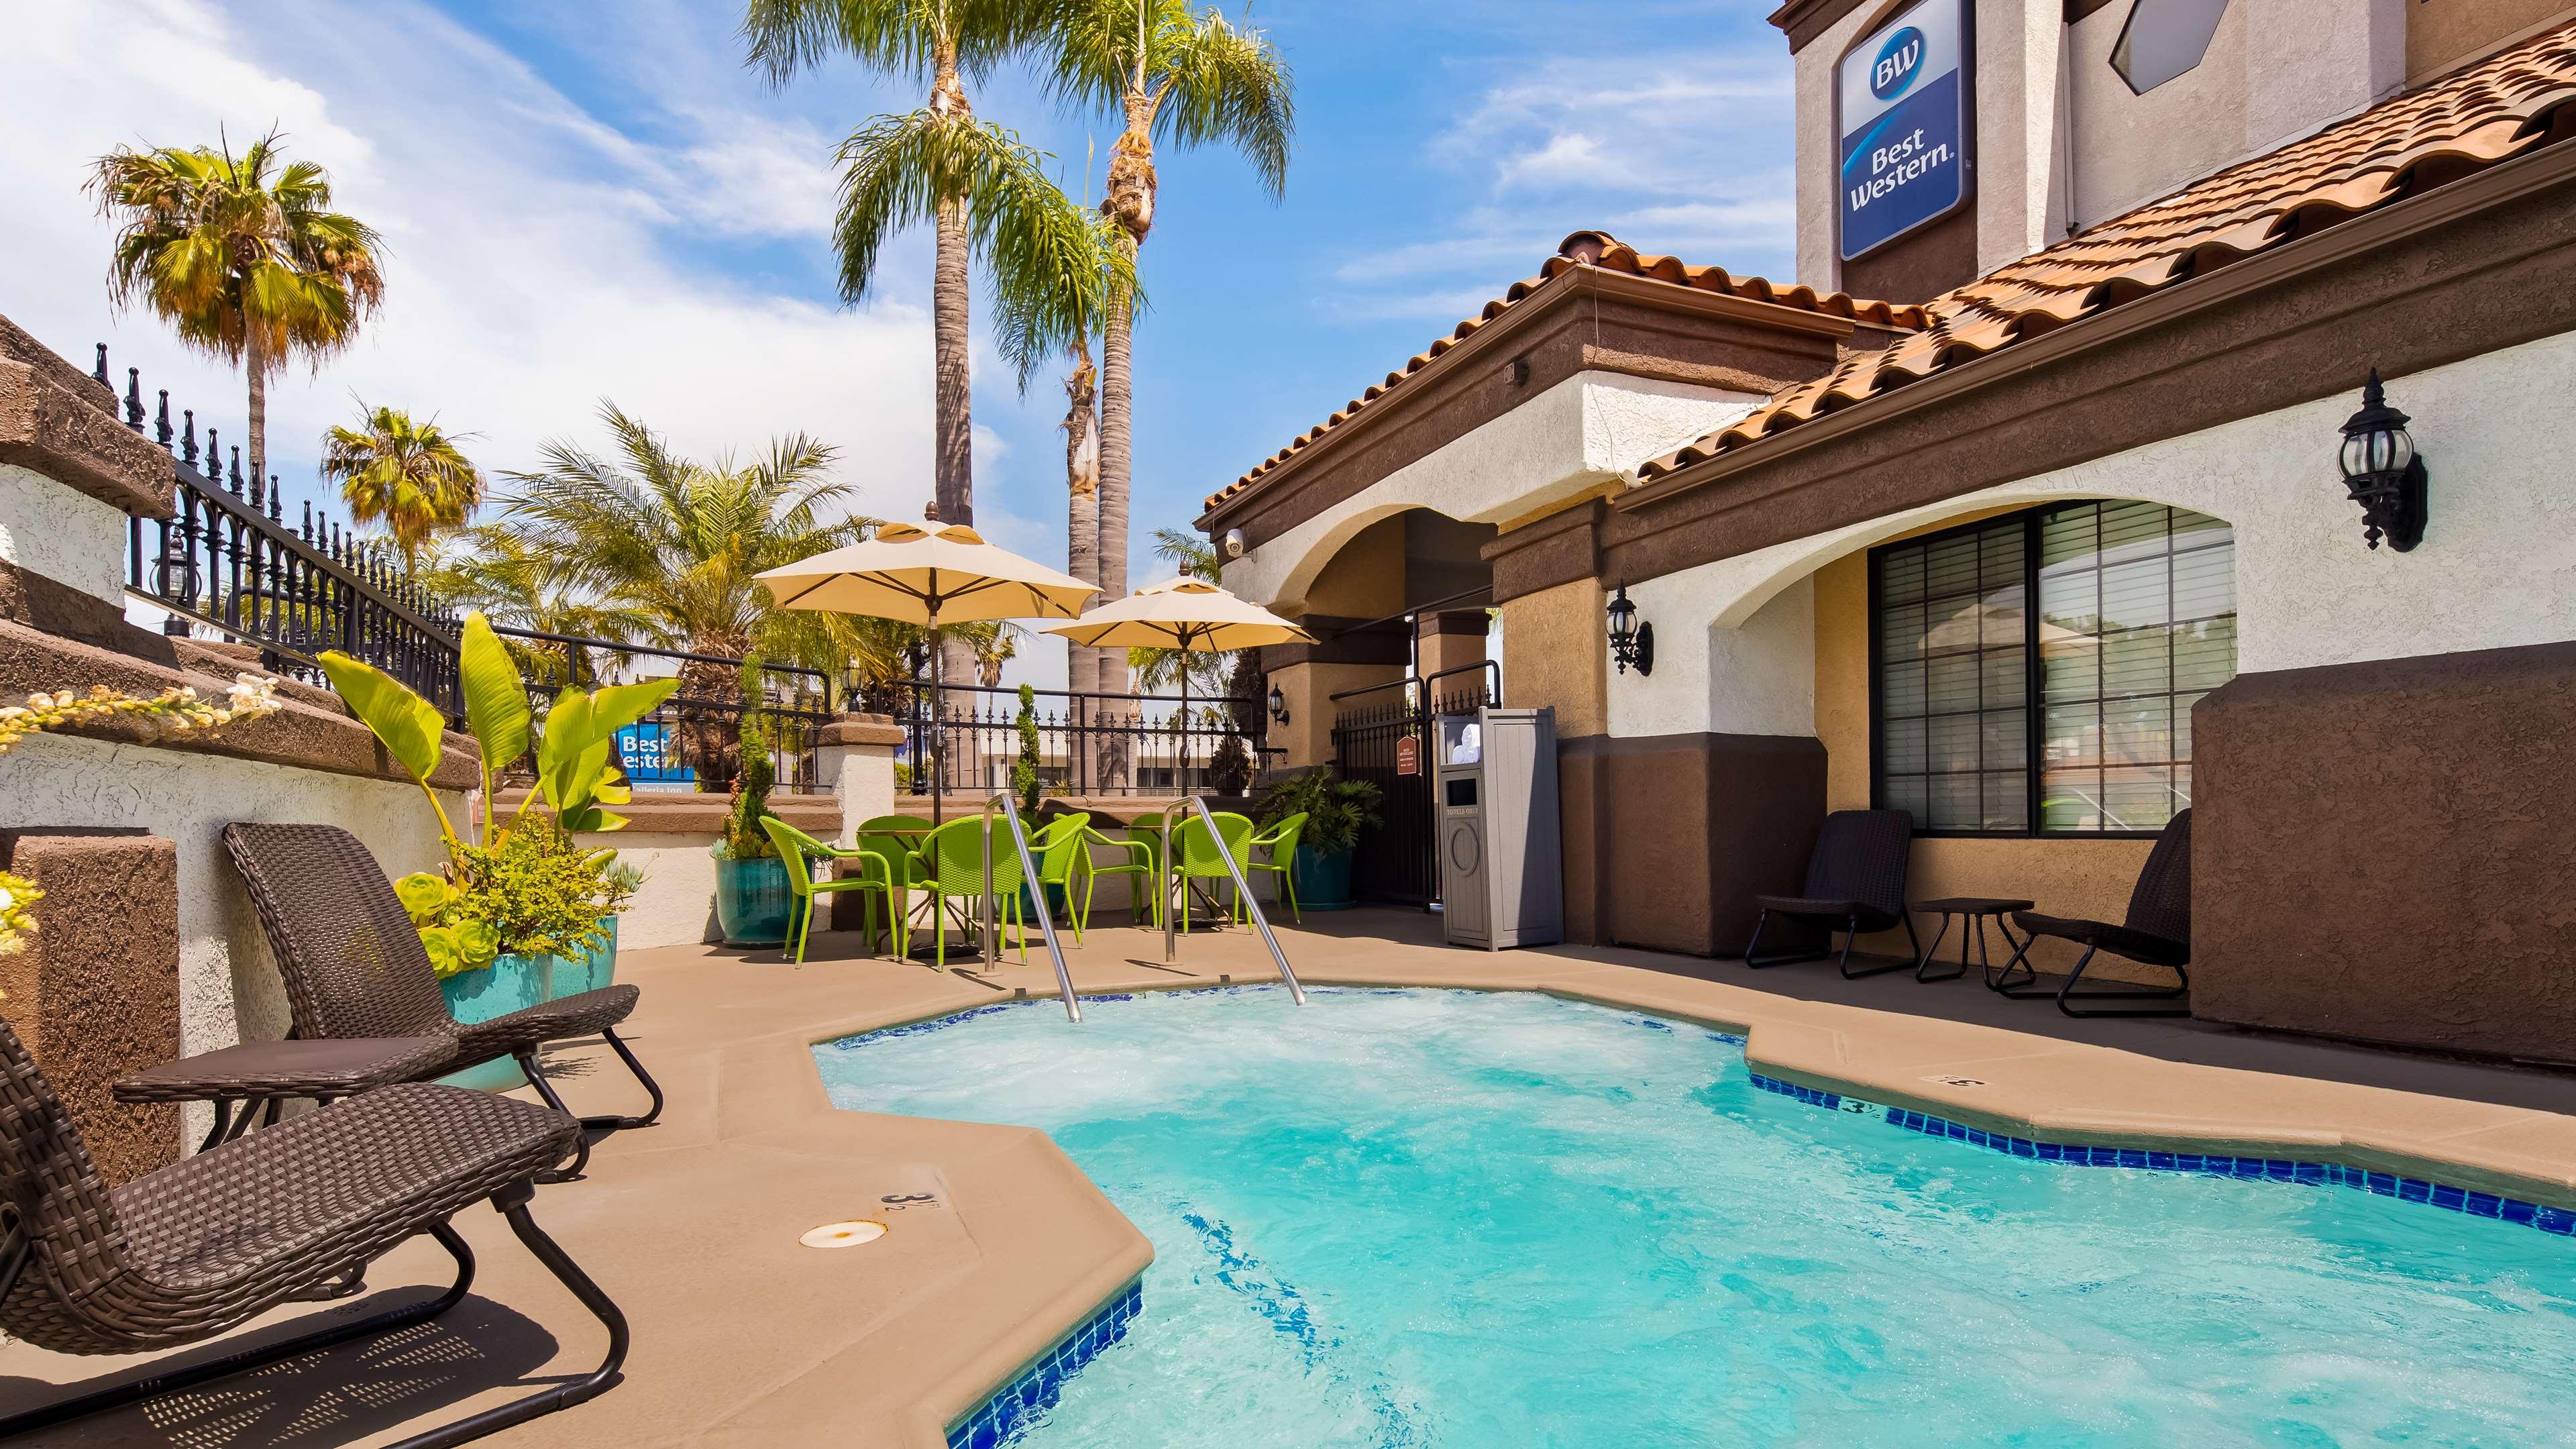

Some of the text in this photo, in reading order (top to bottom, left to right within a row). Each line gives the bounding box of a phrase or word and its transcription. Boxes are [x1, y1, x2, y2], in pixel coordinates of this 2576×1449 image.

[1876, 38, 1919, 91] BW
[1872, 127, 1925, 176] Best
[623, 736, 667, 752] Best
